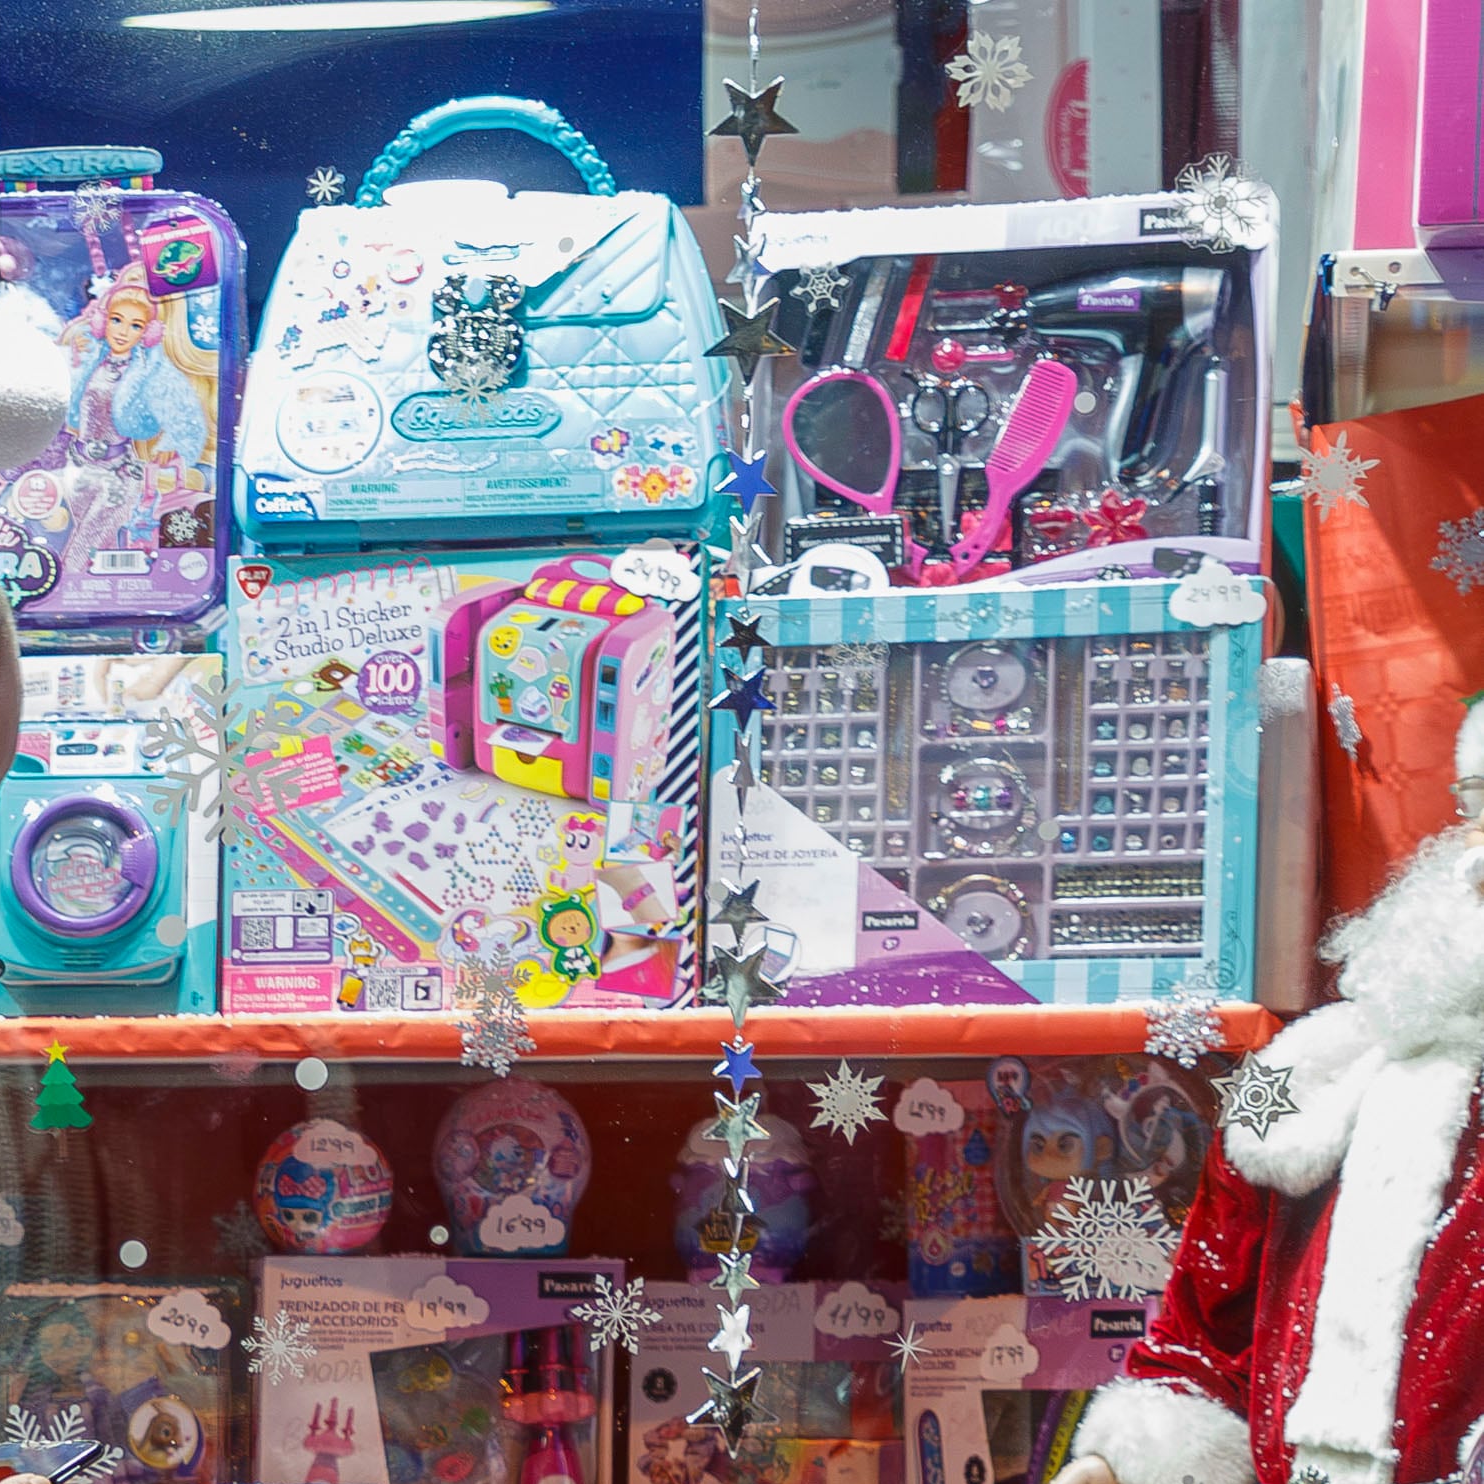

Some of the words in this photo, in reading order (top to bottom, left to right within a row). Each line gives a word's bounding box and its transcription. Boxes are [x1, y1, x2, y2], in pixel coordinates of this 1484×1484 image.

[3, 152, 134, 176] EXTRA
[486, 477, 572, 491] AVERTISSEMENT:
[630, 556, 683, 594] 24'99
[277, 617, 292, 638] 2
[297, 619, 319, 636] in
[336, 601, 413, 628] Sticker
[274, 634, 345, 662] Studio
[349, 623, 423, 650] Deluxe
[365, 664, 416, 694] 100
[791, 847, 839, 861] JOYERÍA
[254, 975, 322, 991] WARNING:
[309, 1138, 356, 1154] 12'99
[496, 1214, 547, 1236] 16'99
[281, 1274, 344, 1290] juguettos
[363, 1301, 381, 1313] DE
[312, 1314, 400, 1328] ACCESORIOS
